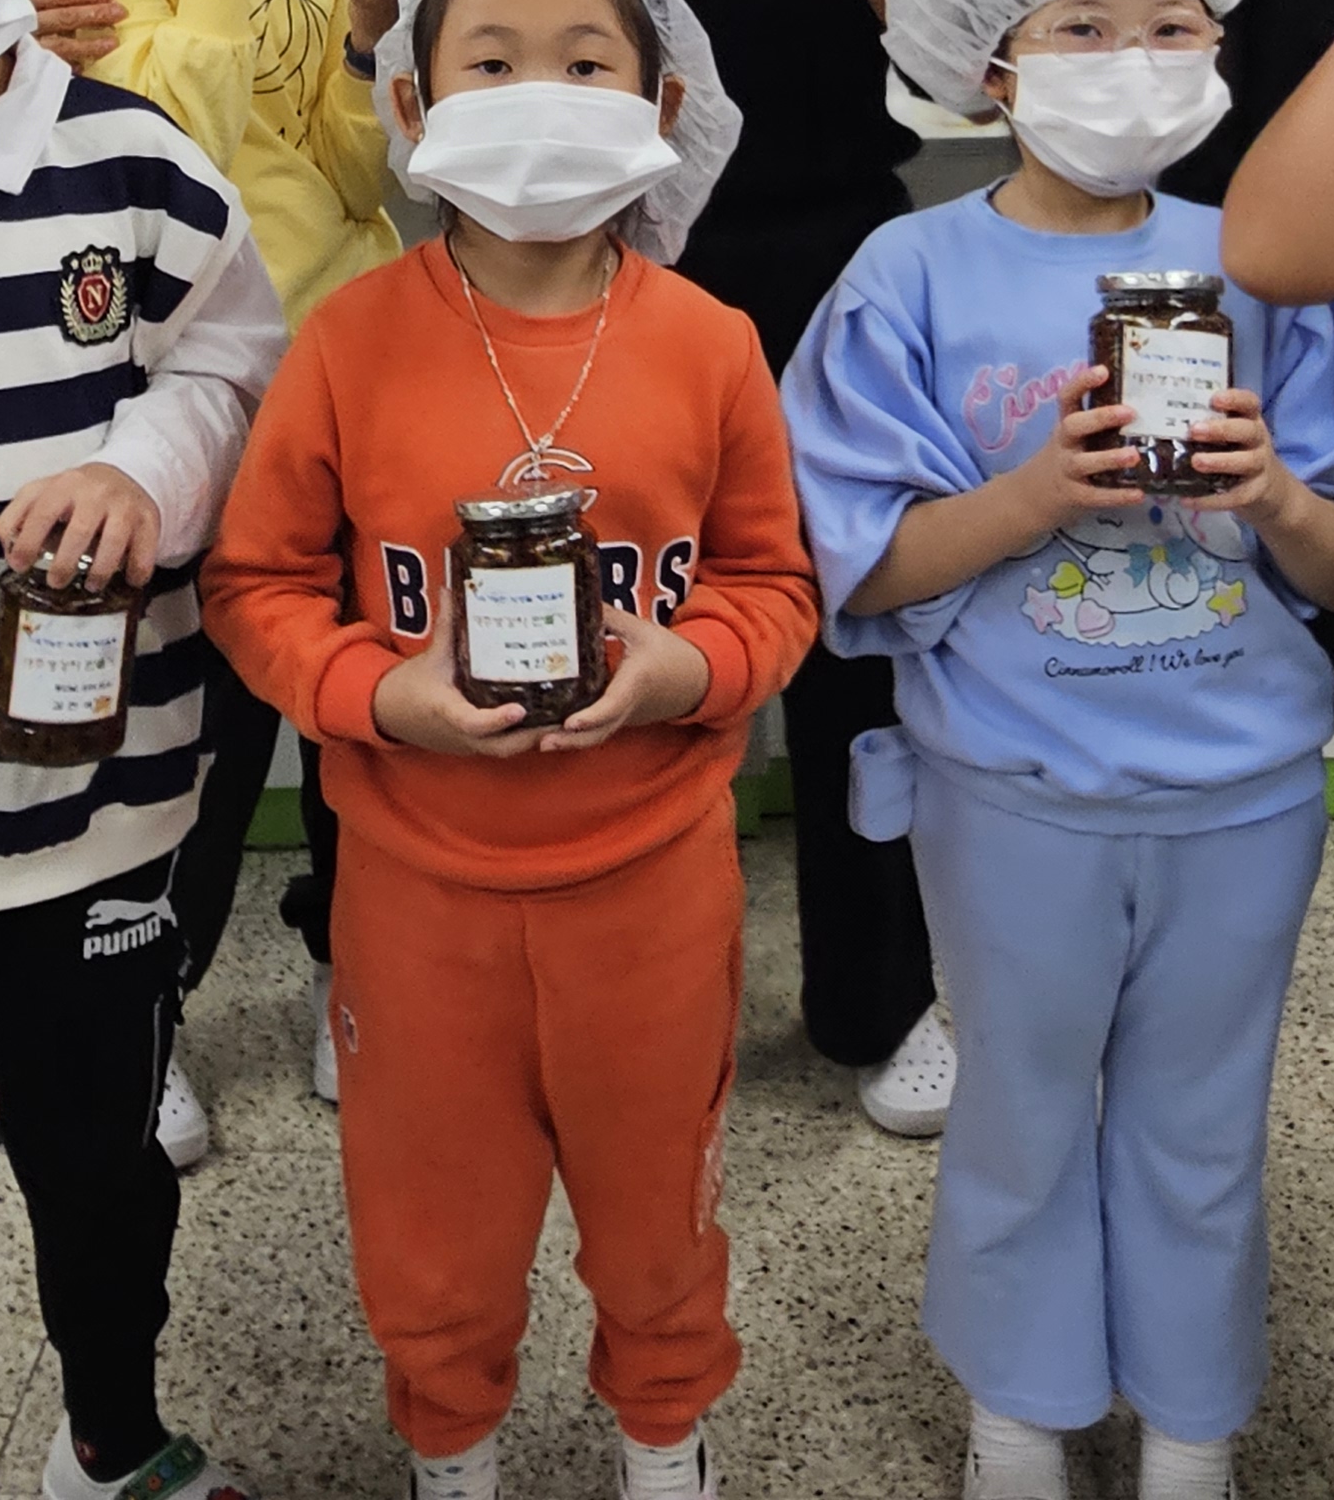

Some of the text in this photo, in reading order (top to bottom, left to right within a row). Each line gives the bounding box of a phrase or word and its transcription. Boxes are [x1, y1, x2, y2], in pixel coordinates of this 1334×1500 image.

[85, 284, 104, 309] N
[380, 536, 697, 641] BRS
[83, 915, 162, 961] PUMA
